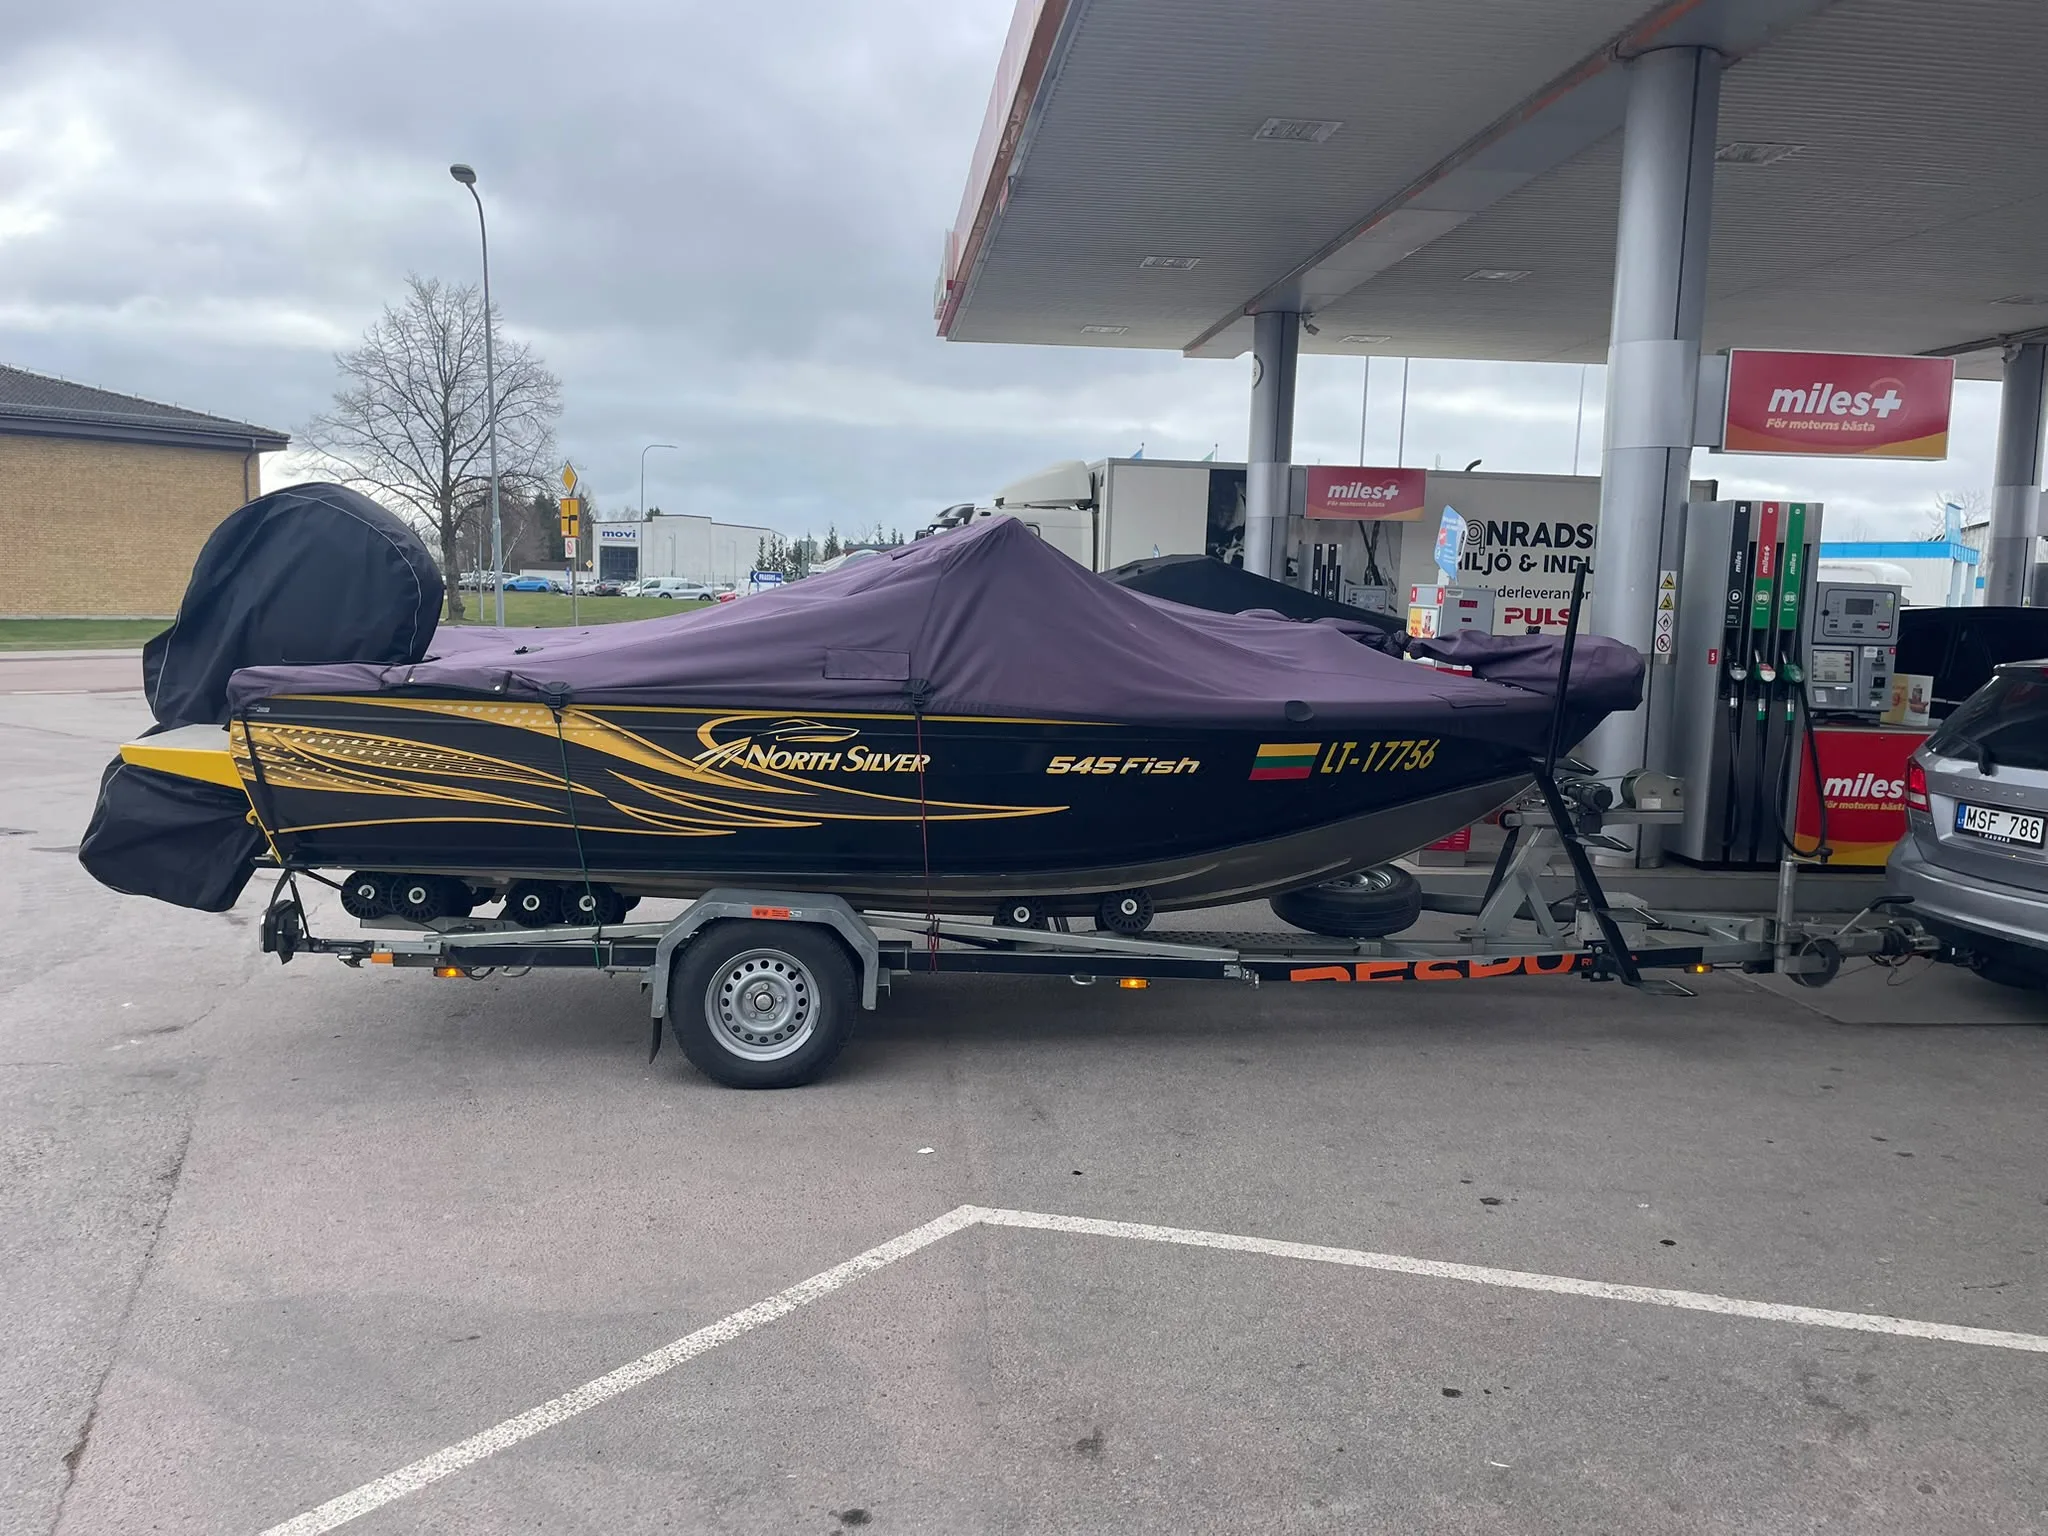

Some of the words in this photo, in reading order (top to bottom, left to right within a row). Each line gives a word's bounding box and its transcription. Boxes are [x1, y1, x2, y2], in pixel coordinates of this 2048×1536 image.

[1767, 382, 1903, 418] miles+
[1766, 418, 1787, 430] För
[1789, 420, 1840, 431] motorns
[1841, 420, 1876, 432] bästa
[602, 529, 636, 539] movi
[1458, 548, 1512, 576] ILJÖ
[1519, 554, 1538, 573] &
[1735, 551, 1743, 573] miles
[1046, 755, 1121, 775] 545
[1121, 757, 1201, 775] Fish
[1321, 739, 1441, 775] LT-17756
[1838, 801, 1879, 810] motorns
[1966, 808, 1999, 831] MSF
[2009, 815, 2040, 840] 786
